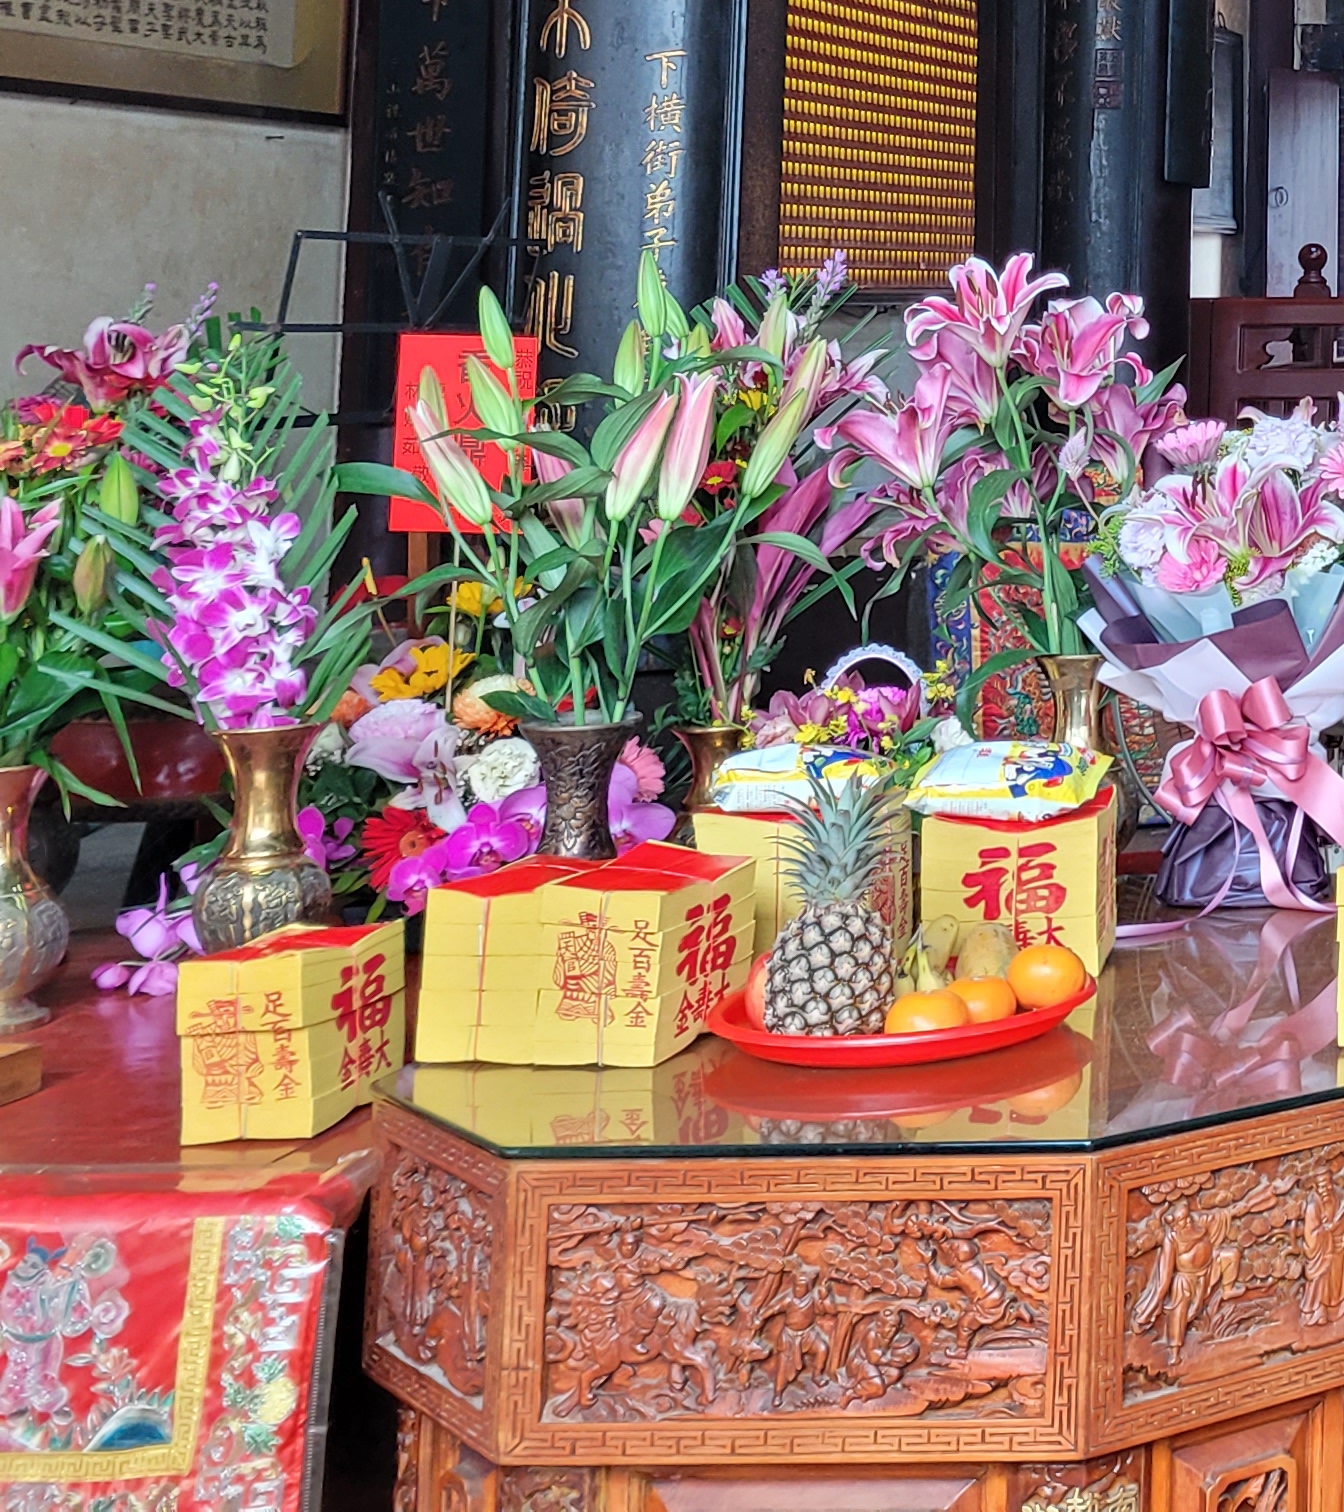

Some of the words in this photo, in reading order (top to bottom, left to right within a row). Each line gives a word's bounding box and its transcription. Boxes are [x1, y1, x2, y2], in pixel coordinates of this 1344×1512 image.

[960, 841, 1067, 921] 福
[622, 919, 660, 1028] 足百壽金
[675, 892, 738, 987] 福
[260, 990, 303, 1101] 足百壽金
[330, 952, 393, 1044] 福
